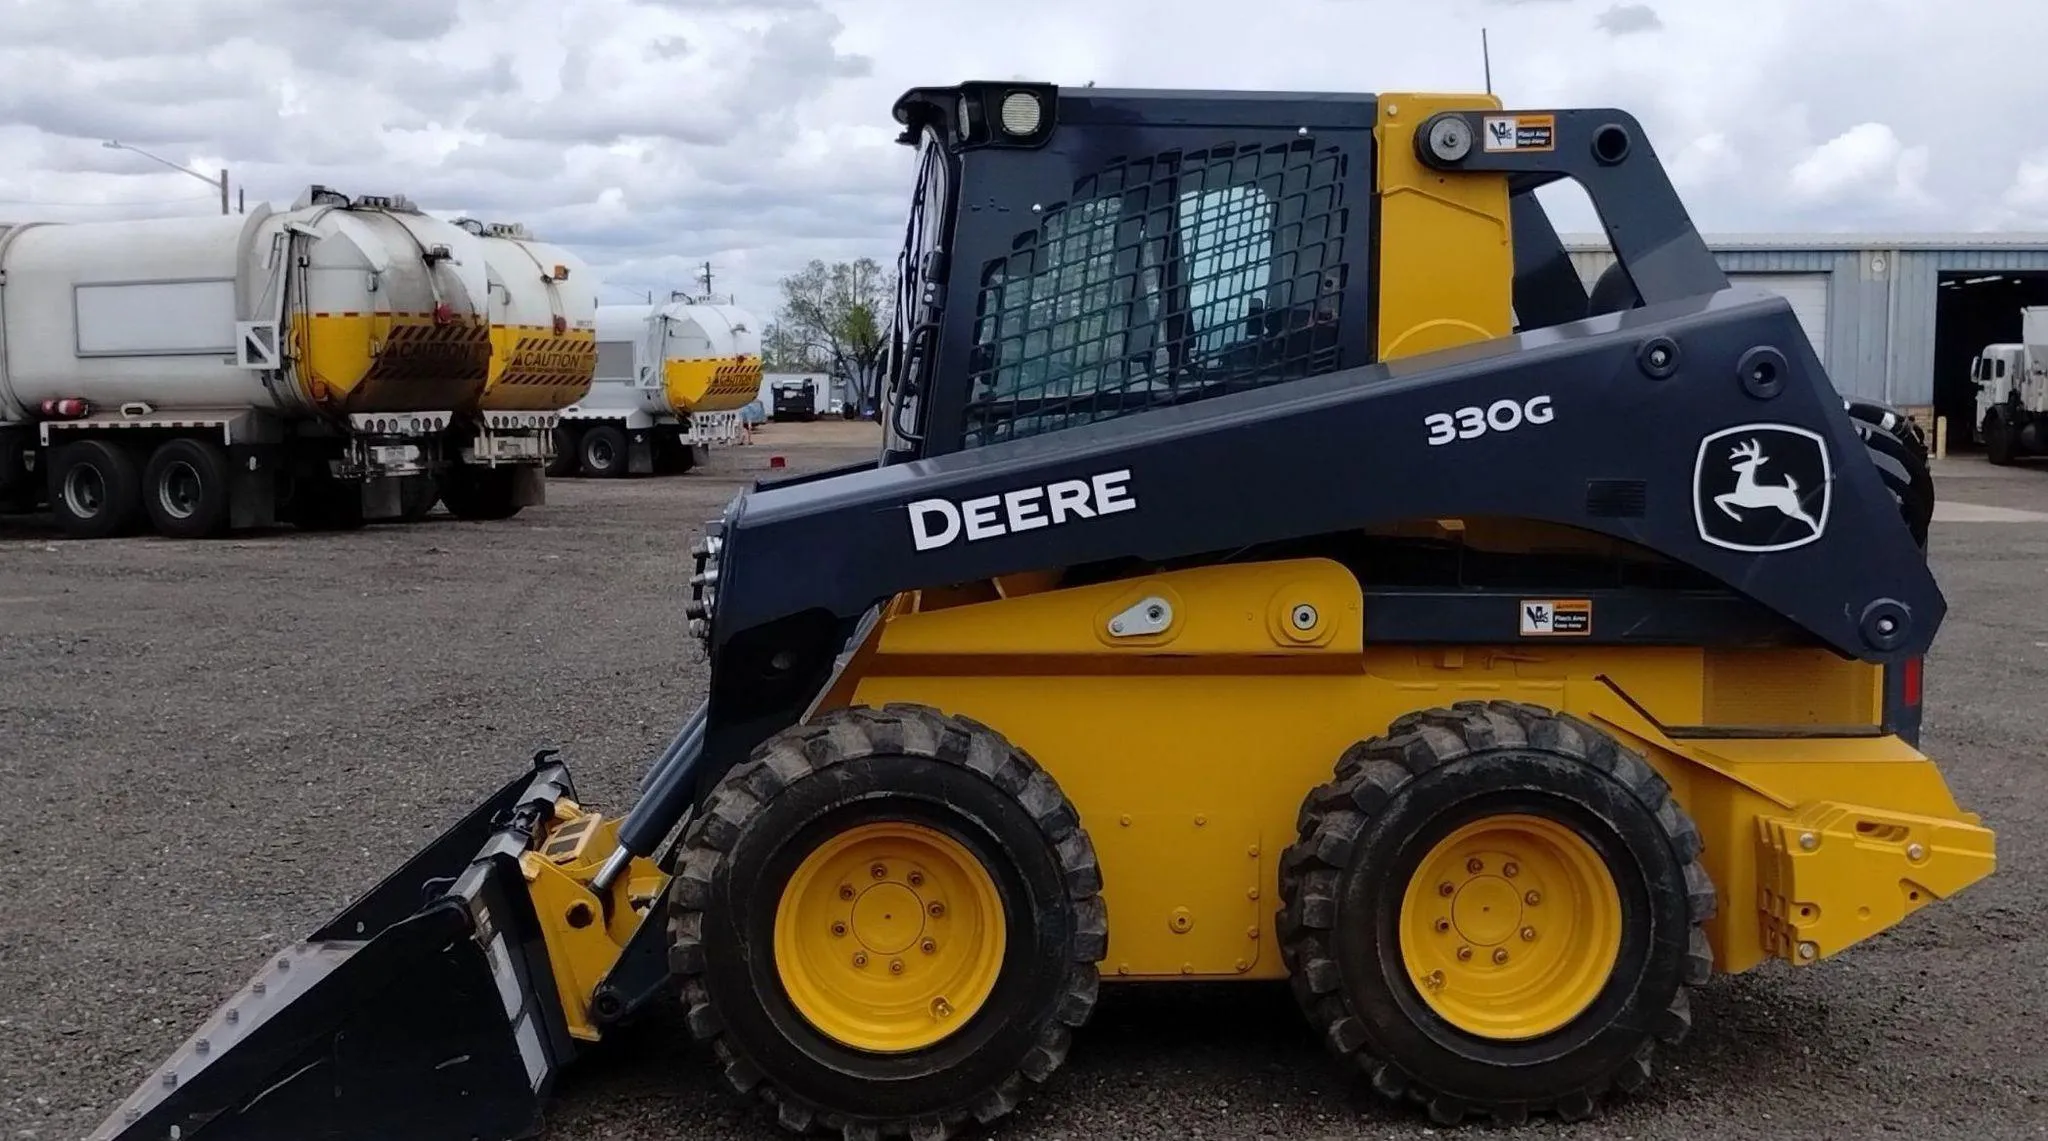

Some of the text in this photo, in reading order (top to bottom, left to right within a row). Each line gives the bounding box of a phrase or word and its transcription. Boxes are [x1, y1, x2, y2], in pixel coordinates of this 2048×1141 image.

[399, 341, 471, 359] CAUTION
[523, 351, 580, 368] CAUTION
[1424, 395, 1554, 445] 330G
[907, 469, 1137, 551] DEERE
